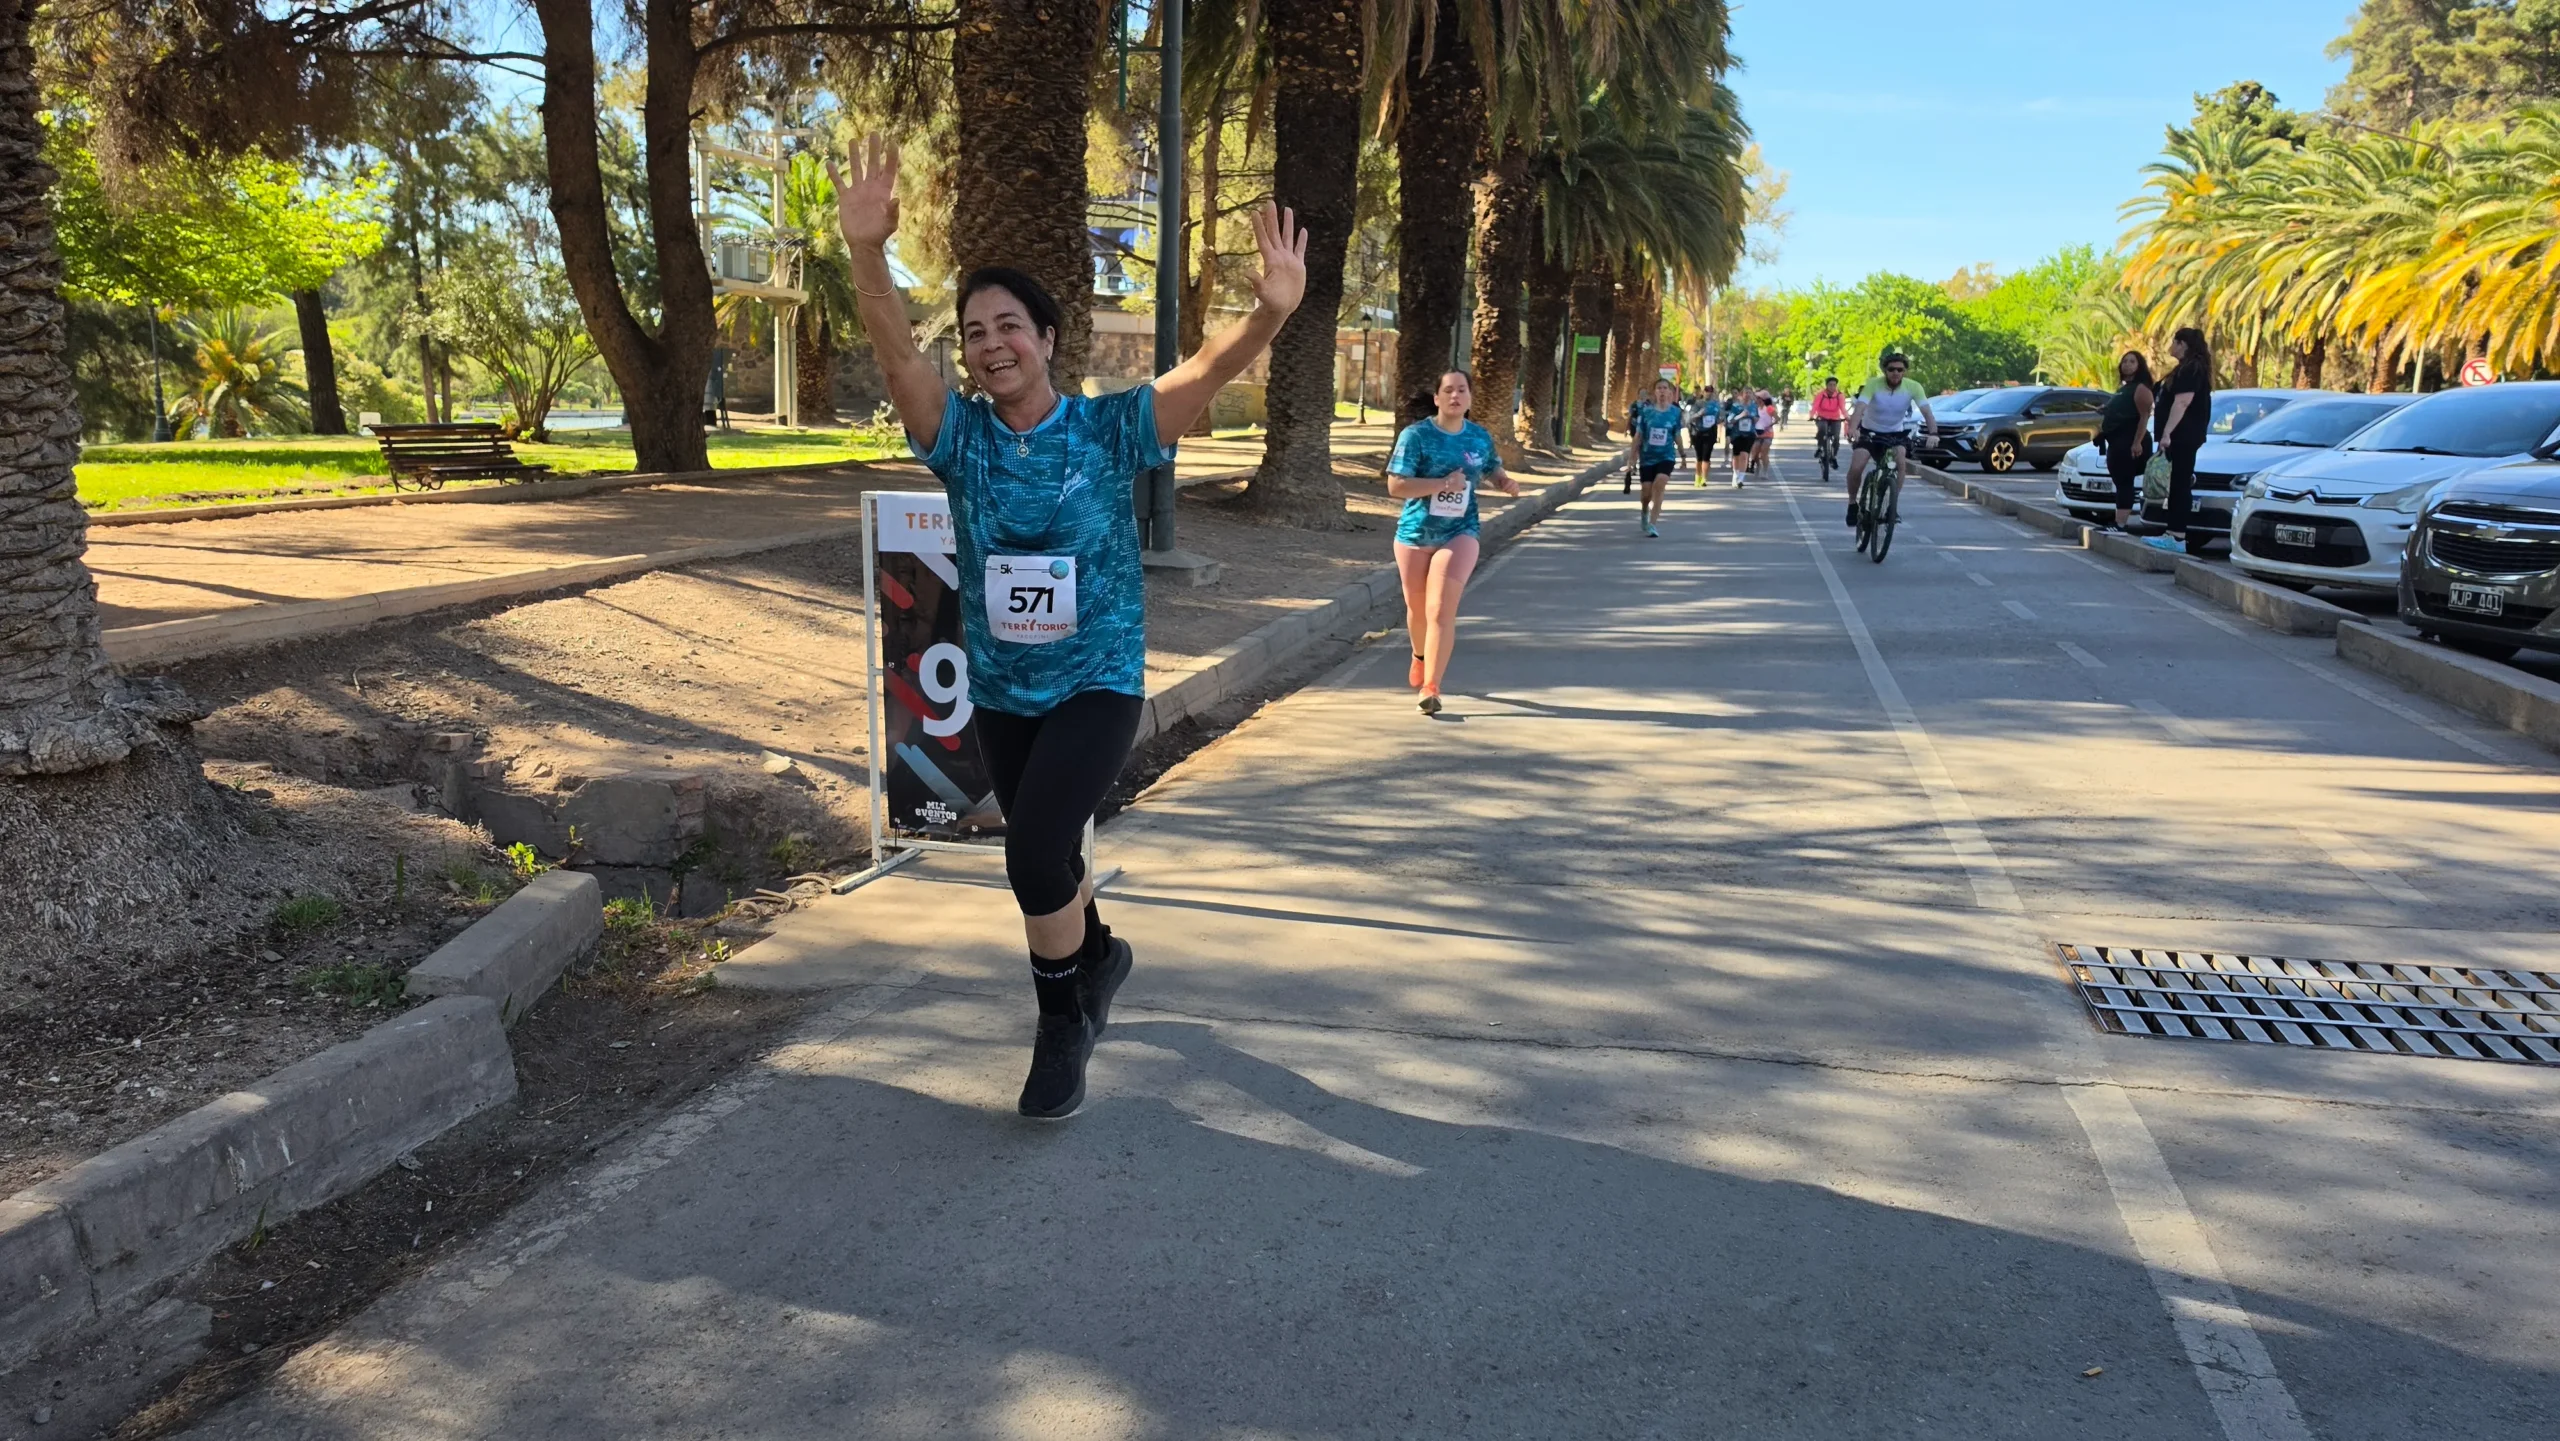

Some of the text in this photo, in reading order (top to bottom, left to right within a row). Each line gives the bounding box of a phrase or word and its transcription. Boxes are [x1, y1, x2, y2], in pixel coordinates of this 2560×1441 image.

[1437, 491, 1463, 504] 668
[1000, 564, 1013, 574] 5k
[1008, 587, 1054, 613] 571
[2450, 590, 2500, 610] MJP 441
[1001, 619, 1068, 631] TERRITORIO
[919, 642, 974, 737] 9
[926, 801, 946, 811] MLT
